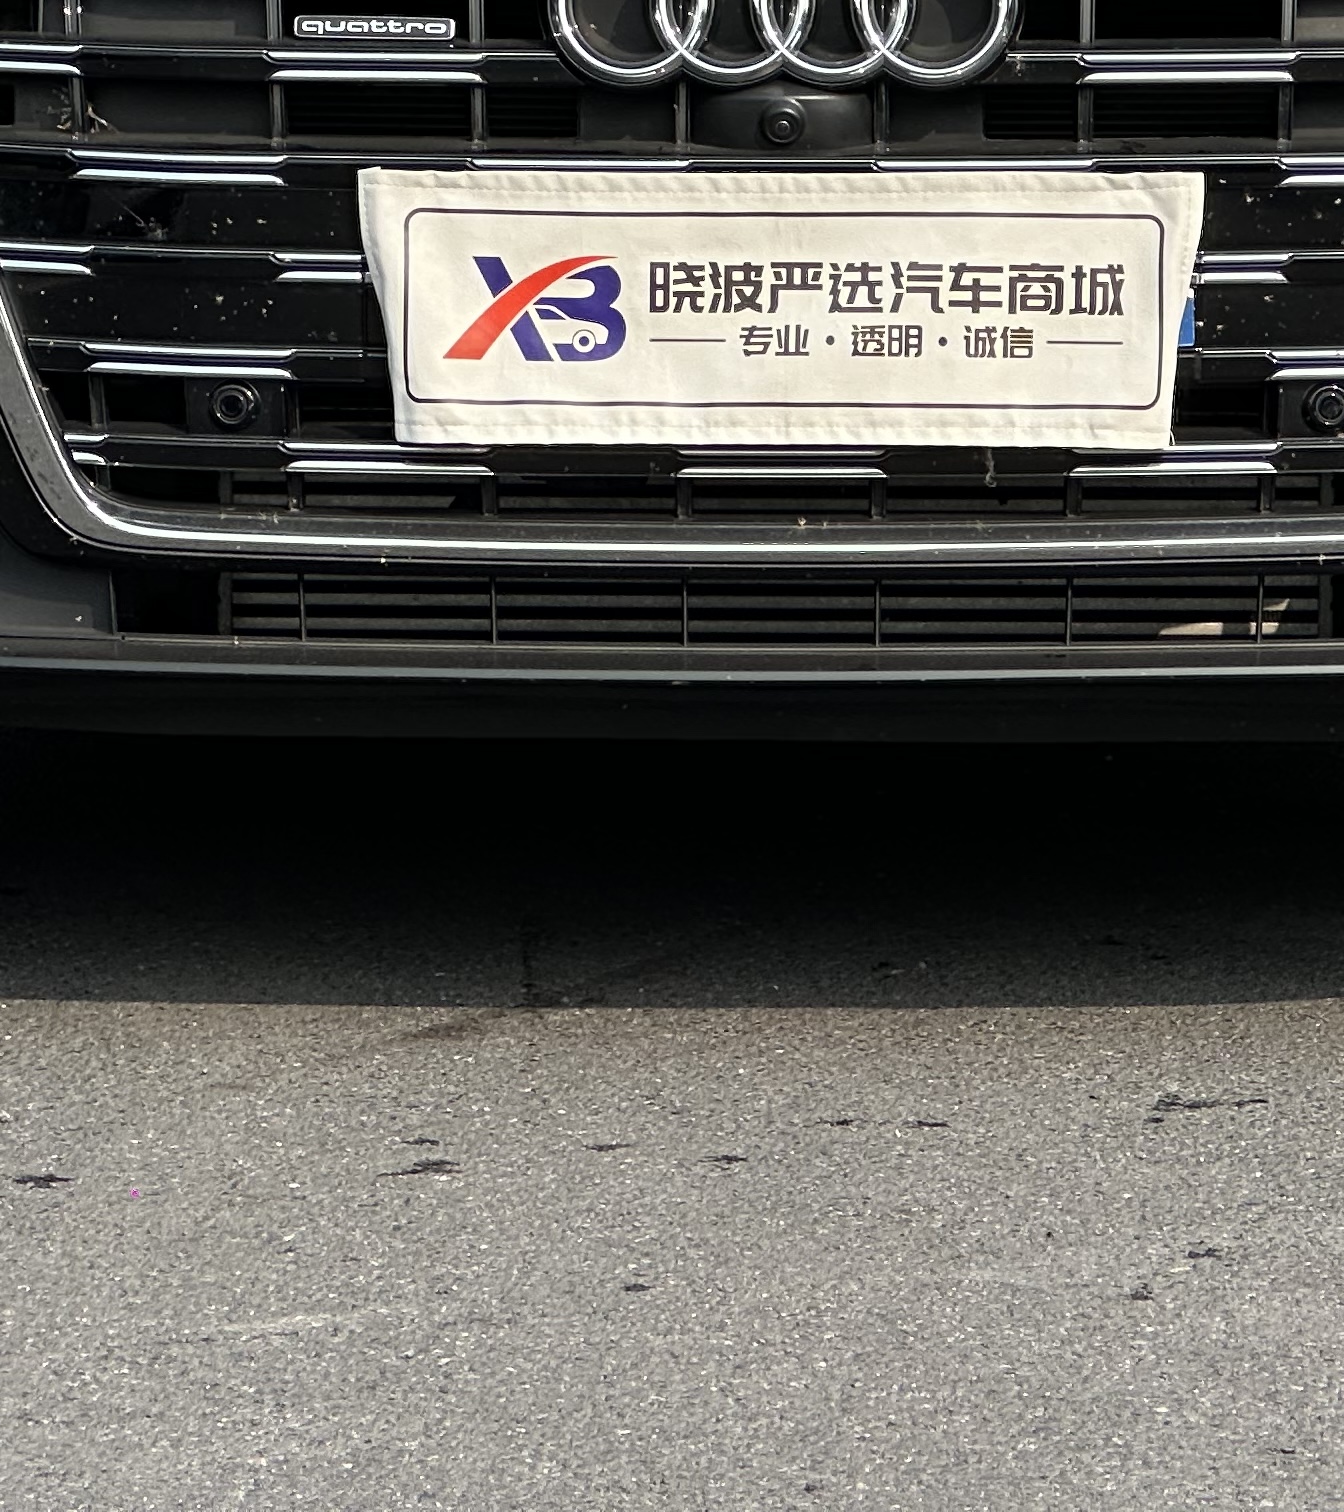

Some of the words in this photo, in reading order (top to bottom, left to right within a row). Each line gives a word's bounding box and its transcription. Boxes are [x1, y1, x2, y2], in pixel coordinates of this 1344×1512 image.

[301, 19, 447, 35] quattro
[648, 261, 1125, 317] 晓波严选汽车商城
